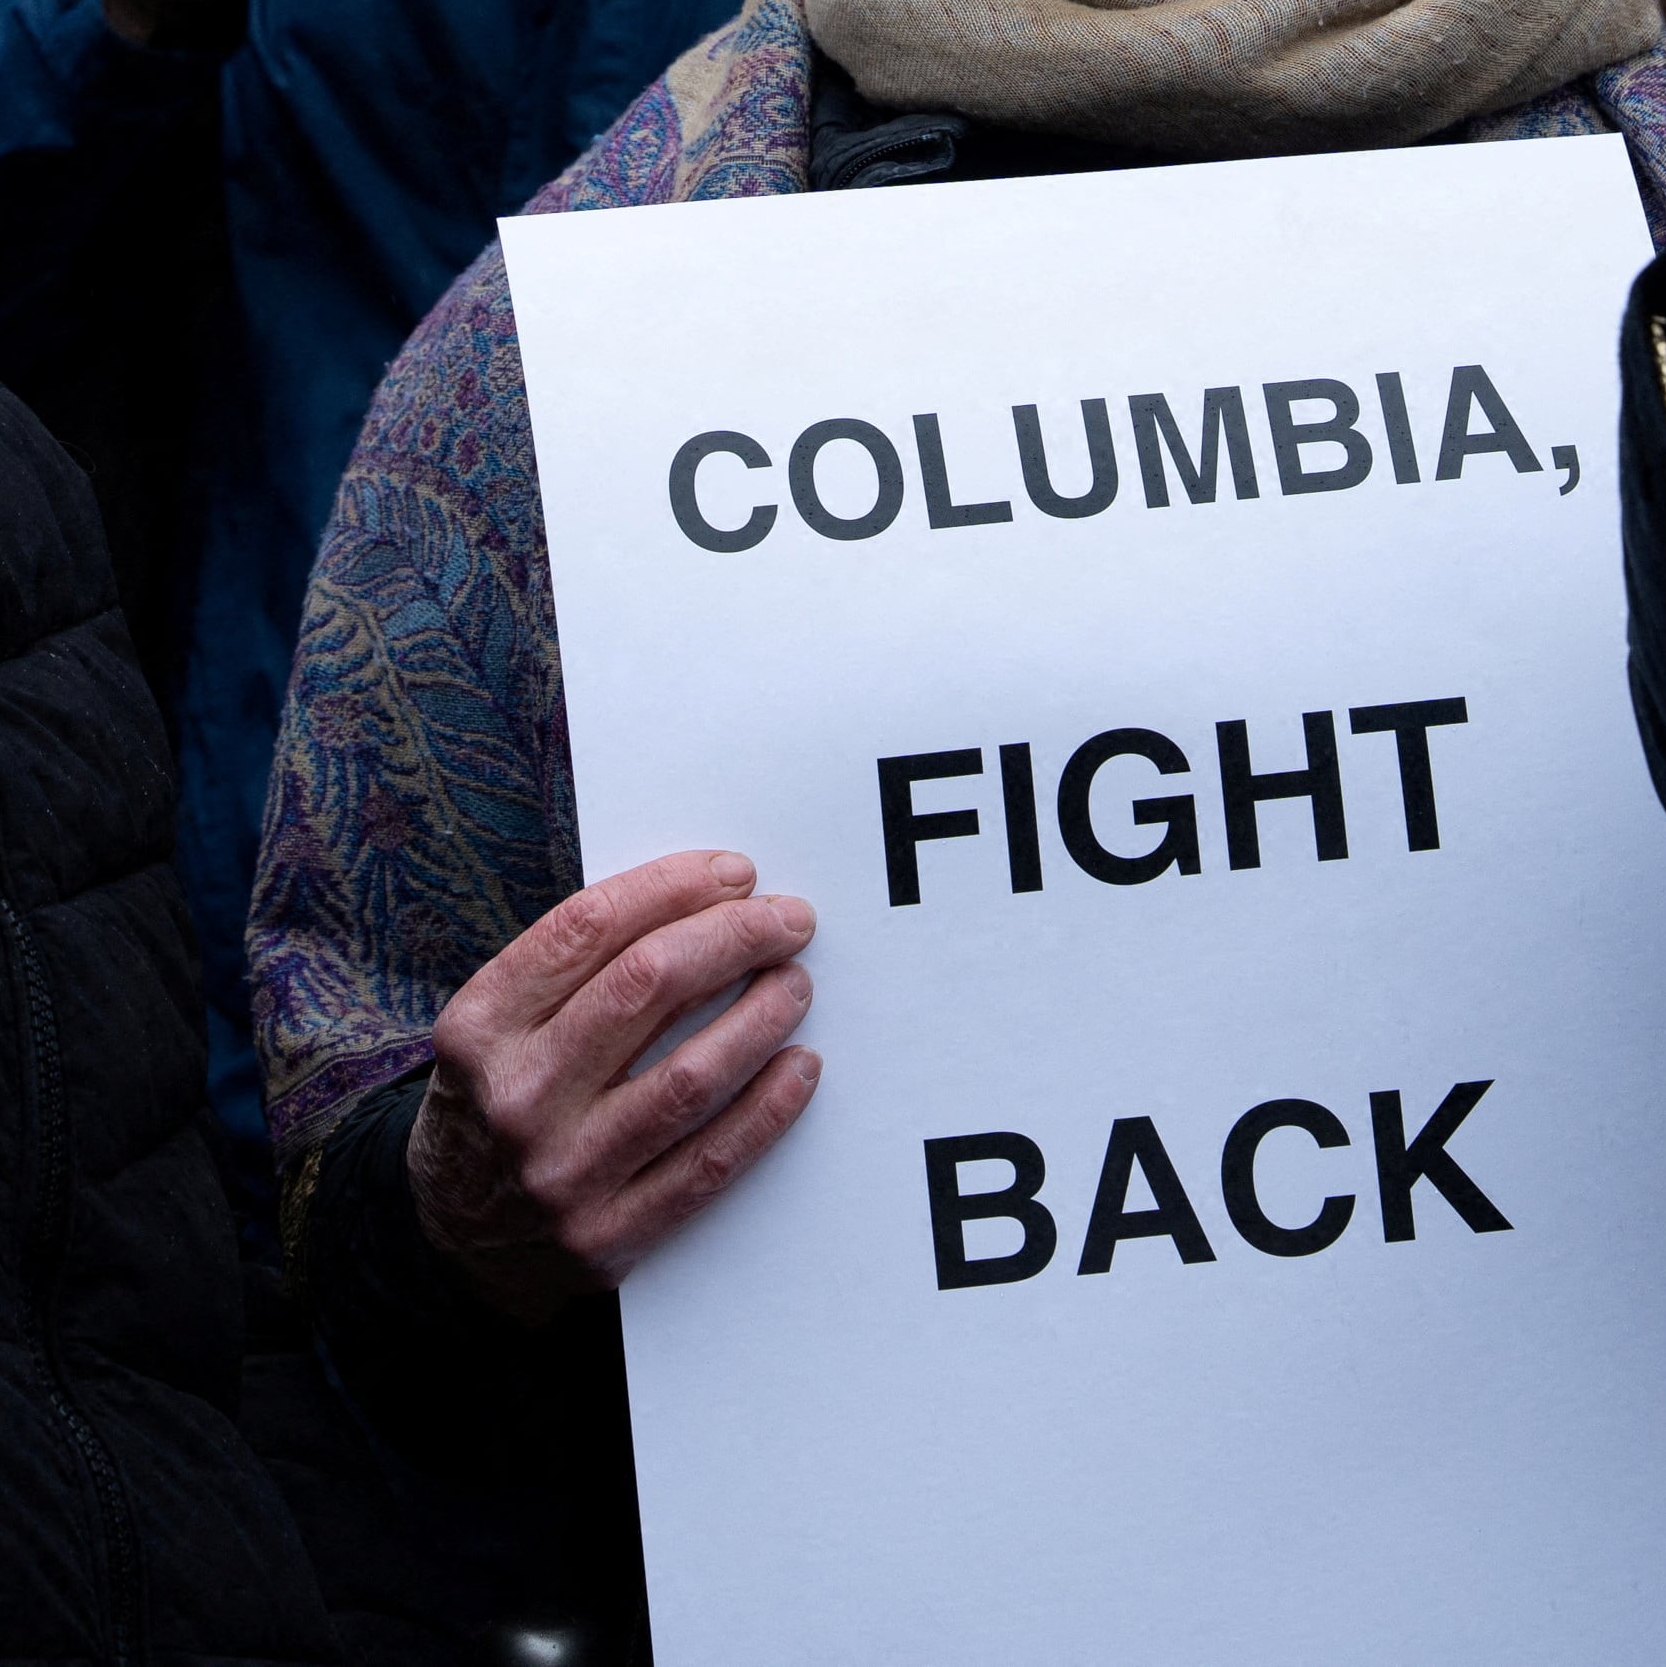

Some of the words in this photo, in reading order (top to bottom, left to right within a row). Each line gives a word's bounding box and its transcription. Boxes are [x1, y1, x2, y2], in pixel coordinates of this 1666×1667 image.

[668, 363, 1582, 555] COLUMBIA,
[876, 695, 1470, 908] FIGHT
[923, 1077, 1516, 1292] BACK
